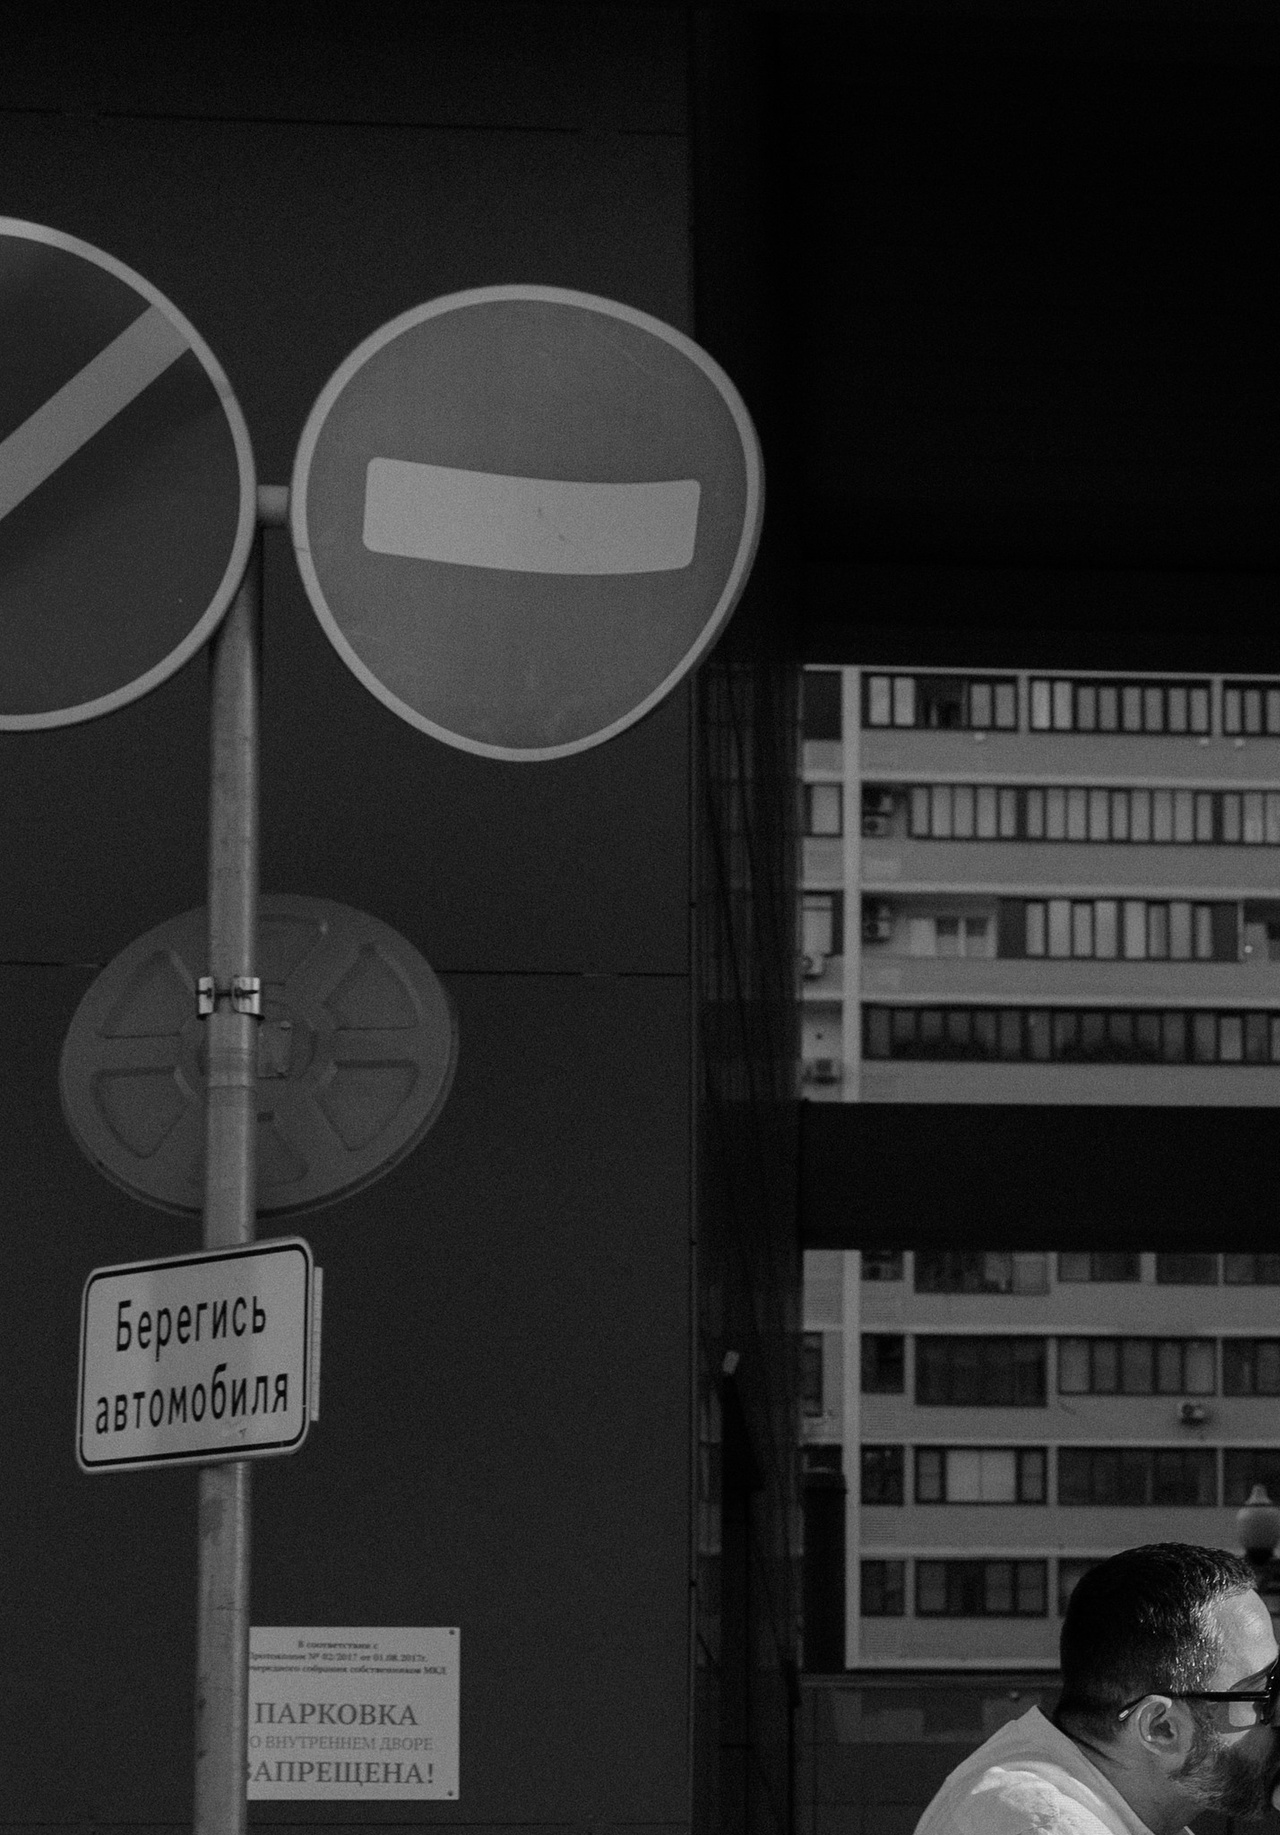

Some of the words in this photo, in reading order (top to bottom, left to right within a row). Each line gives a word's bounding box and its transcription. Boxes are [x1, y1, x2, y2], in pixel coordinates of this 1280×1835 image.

[116, 1295, 267, 1362] Берегись
[95, 1362, 289, 1435] автомобиля
[255, 1702, 418, 1725] ПАРКОВКА
[265, 1735, 376, 1750] ВНУТРЕННЕМ
[379, 1736, 435, 1751] ДВОРЕ
